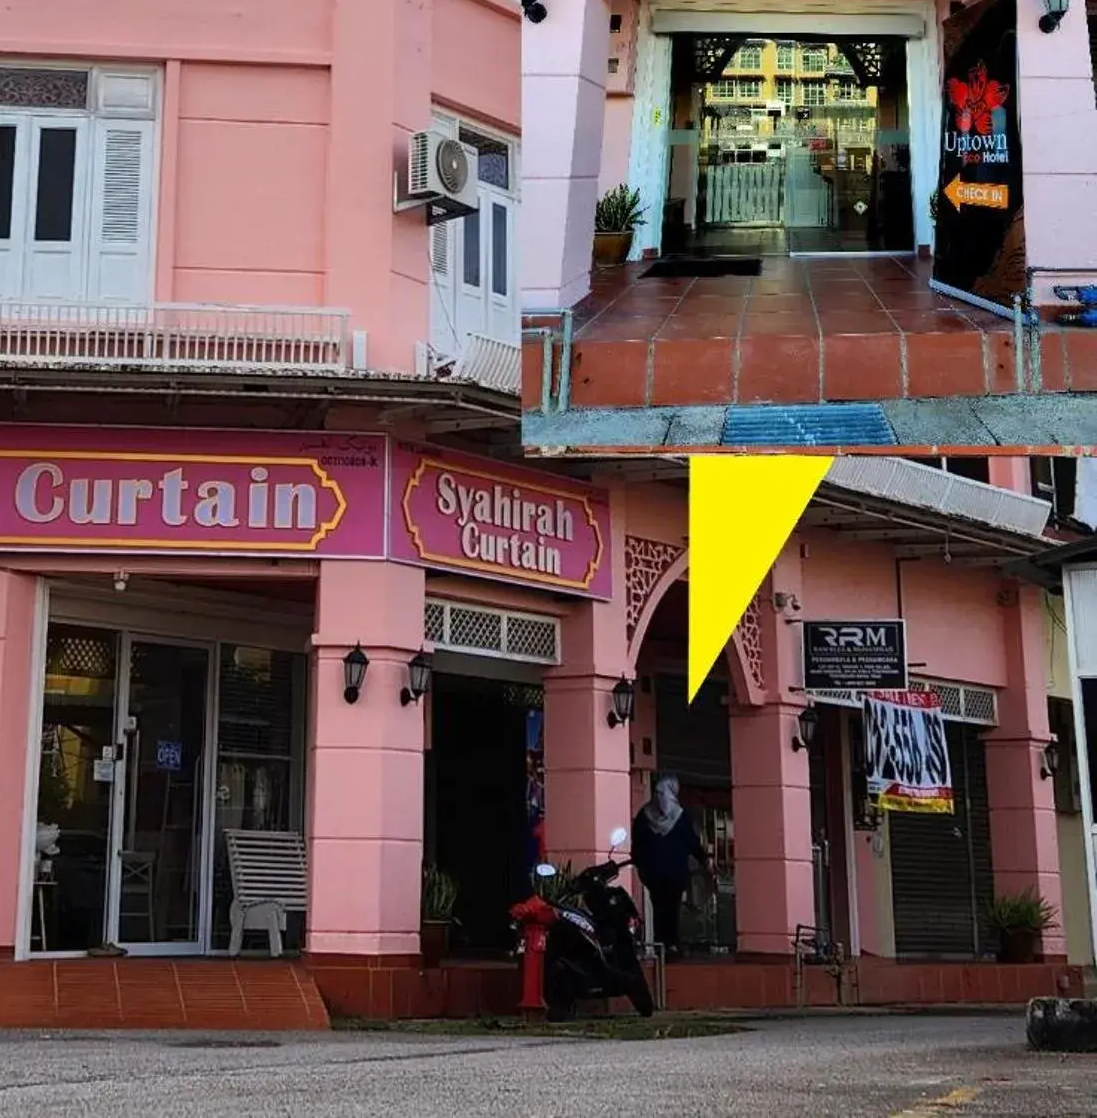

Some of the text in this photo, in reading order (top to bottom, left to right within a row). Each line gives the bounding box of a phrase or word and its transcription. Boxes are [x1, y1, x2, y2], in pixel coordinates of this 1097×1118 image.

[945, 131, 1008, 157] Uptown
[983, 150, 1009, 163] Hotel
[956, 186, 1002, 202] CHECK IN
[14, 461, 318, 530] Curtain
[437, 472, 574, 542] Syahirah
[461, 521, 562, 576] Curtain
[818, 627, 887, 647] RRM
[157, 748, 181, 764] OPEN
